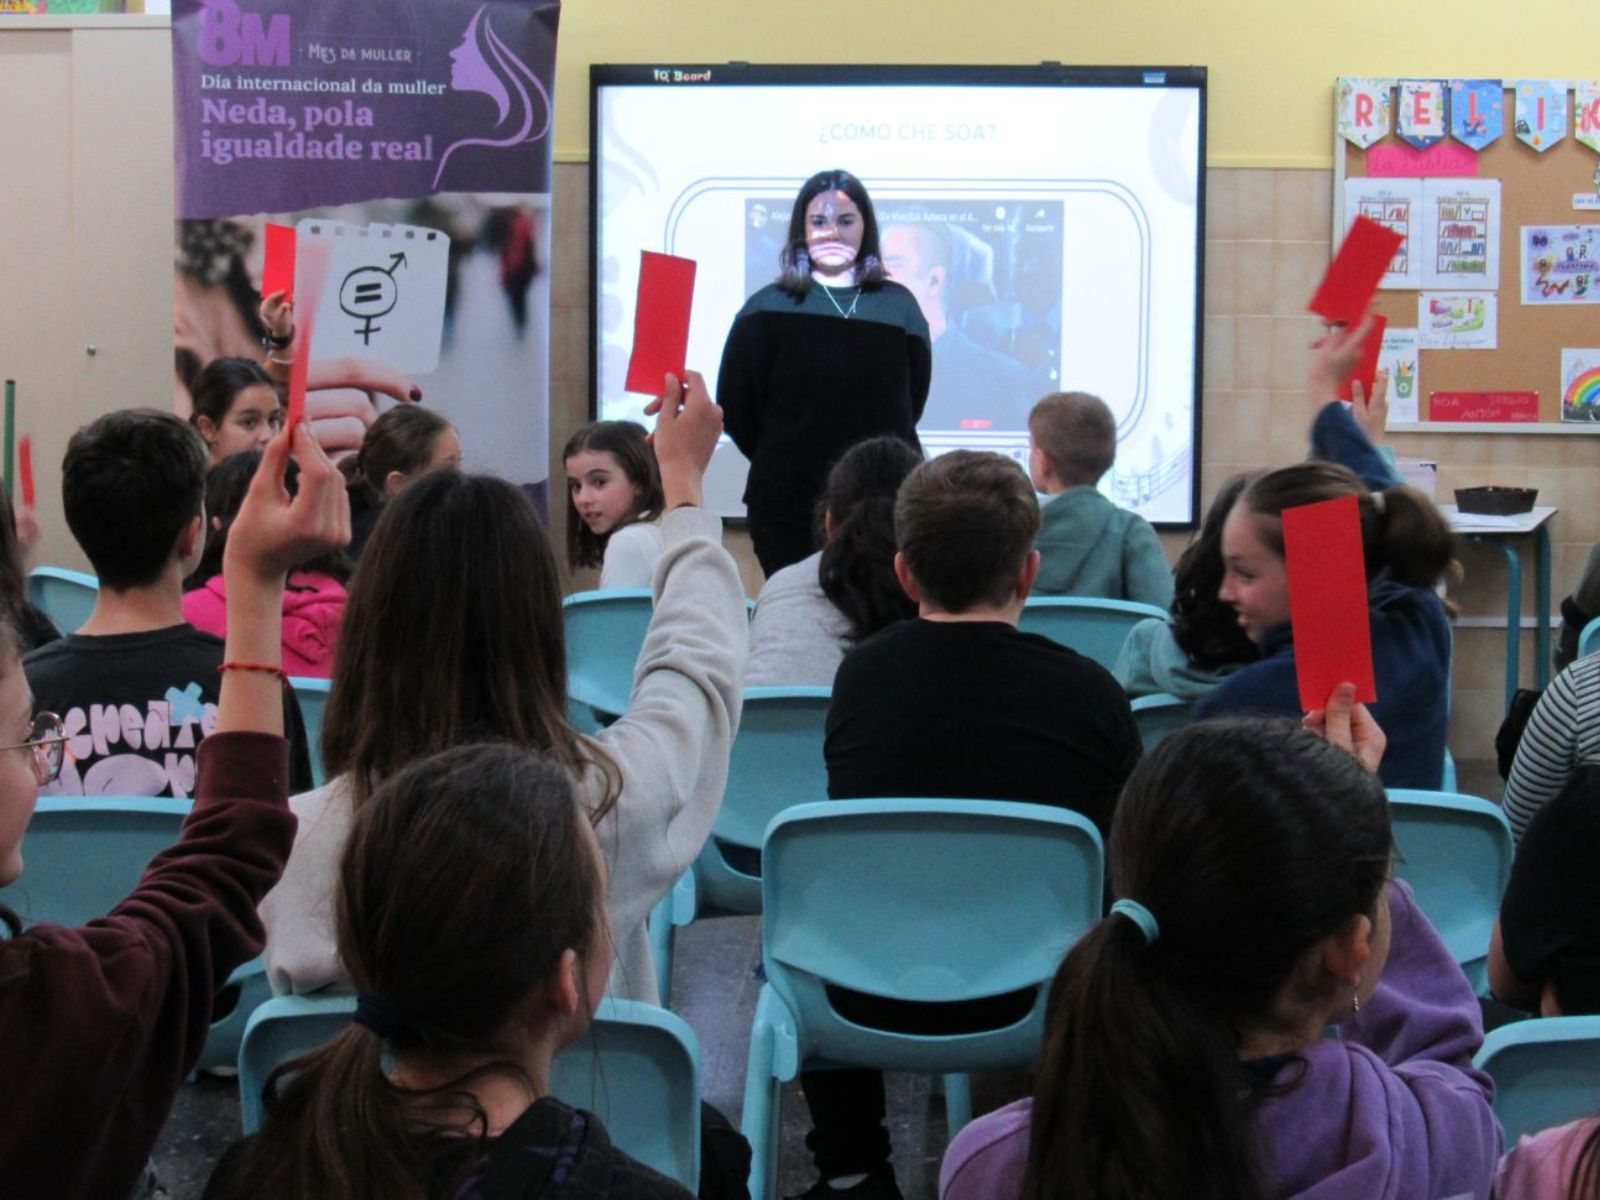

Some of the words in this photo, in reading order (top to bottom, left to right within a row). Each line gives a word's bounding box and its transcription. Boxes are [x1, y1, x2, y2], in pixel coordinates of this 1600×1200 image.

[200, 0, 292, 67] 8M
[201, 75, 231, 90] Día
[237, 75, 356, 93] internacional
[362, 78, 384, 94] da
[388, 80, 447, 96] muller
[673, 69, 712, 82] Board
[202, 99, 296, 131] Neda,
[304, 101, 374, 129] pola
[819, 122, 892, 144] ¿COMO
[898, 122, 938, 141] CHE
[944, 122, 998, 142] SOA?
[200, 130, 363, 165] igualdade
[370, 135, 434, 162] real
